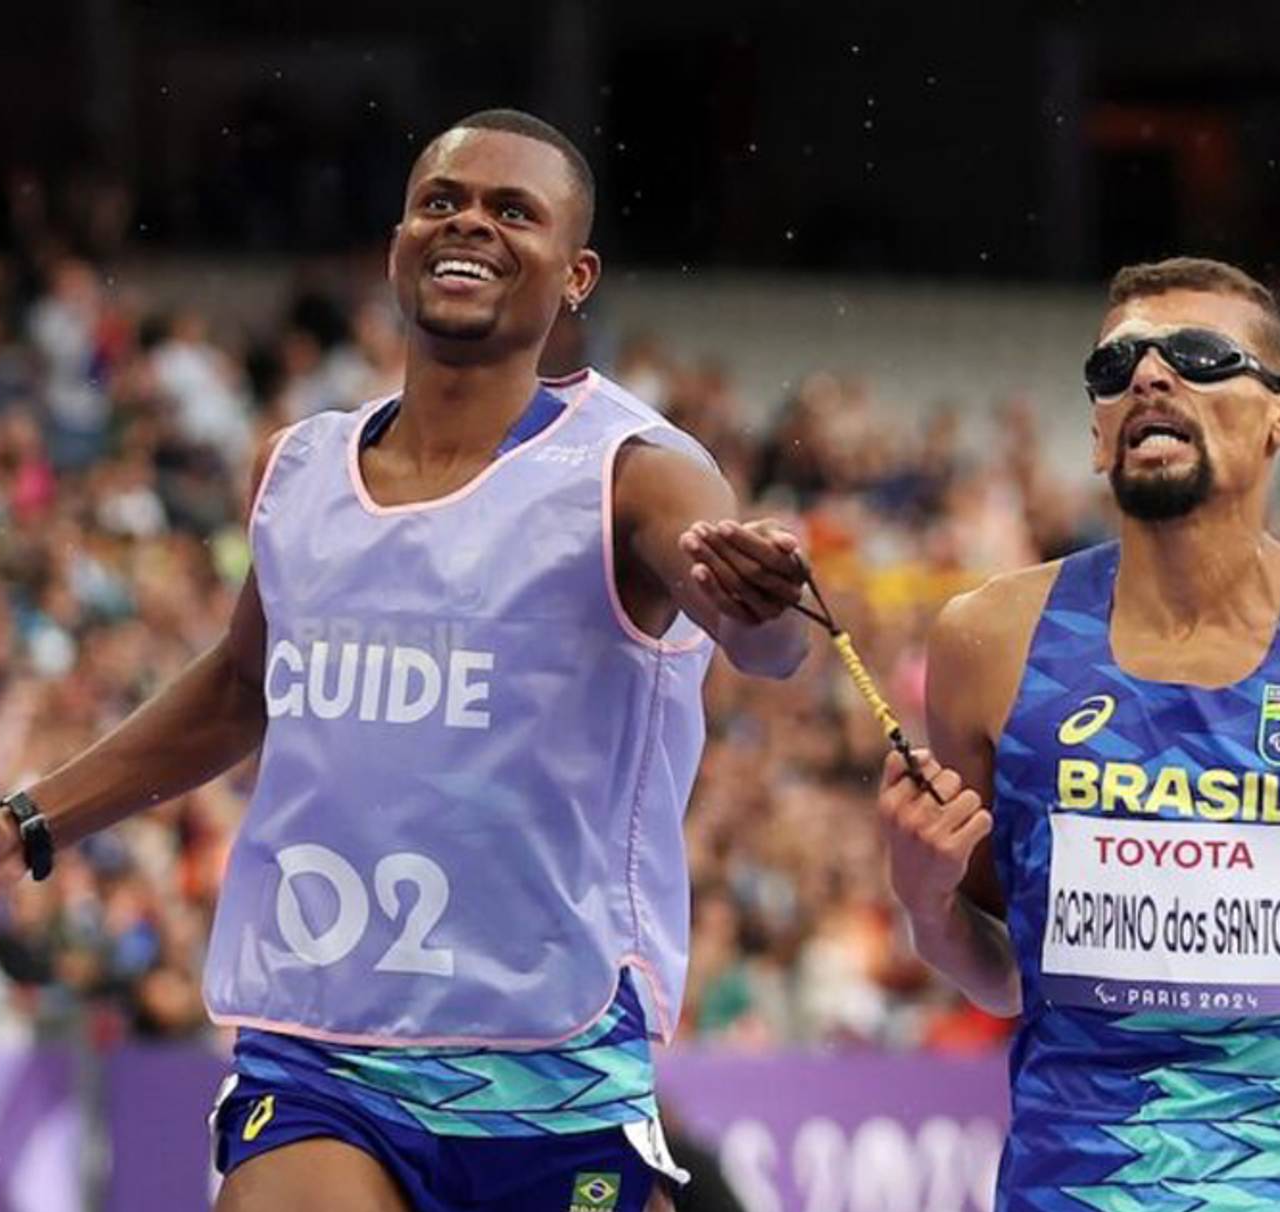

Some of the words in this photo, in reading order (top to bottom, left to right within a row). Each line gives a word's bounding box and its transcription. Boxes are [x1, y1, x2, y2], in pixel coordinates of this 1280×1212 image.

[264, 640, 494, 729] GUIDE
[1094, 835, 1255, 870] TOYOTA
[275, 843, 454, 978] 02
[1163, 897, 1207, 953] dos
[1127, 988, 1191, 1009] PARIS
[1199, 991, 1260, 1009] 2024
